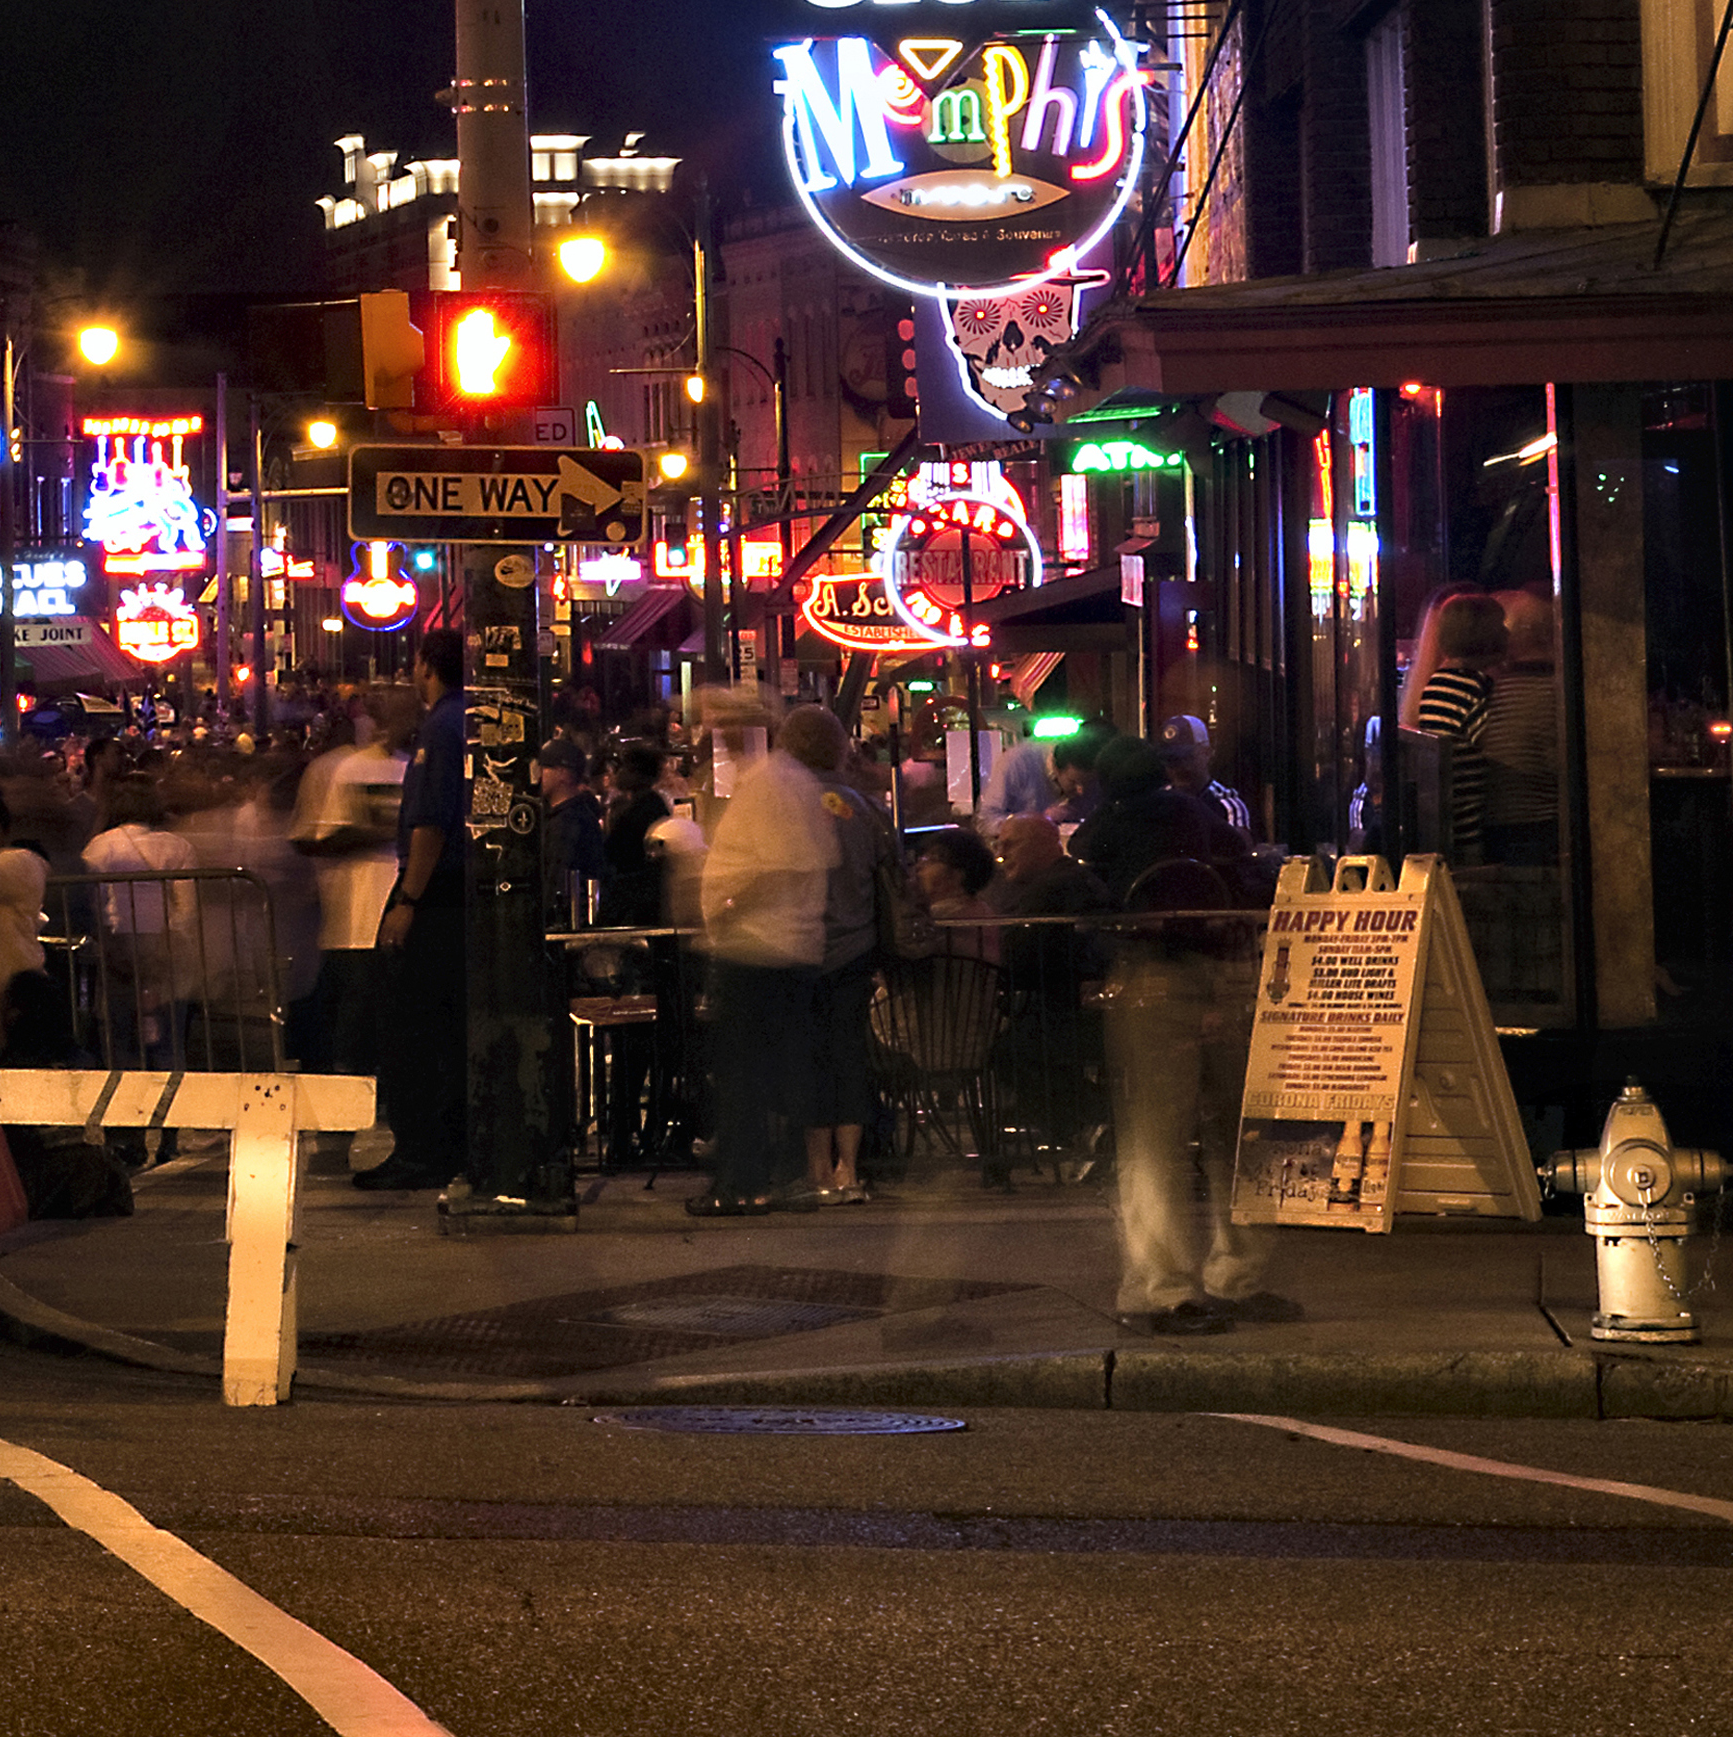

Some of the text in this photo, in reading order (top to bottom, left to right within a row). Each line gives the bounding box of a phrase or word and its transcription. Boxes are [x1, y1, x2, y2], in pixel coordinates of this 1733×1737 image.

[773, 32, 1154, 192] Memphis
[385, 475, 559, 513] ONE WAY
[896, 548, 1028, 587] RESTARANT
[813, 582, 849, 618] A.
[40, 627, 83, 642] JOINT
[843, 624, 925, 640] ESTABLISHE
[1272, 910, 1418, 932] HAPPY HOUR
[1339, 956, 1363, 966] WELL
[1365, 956, 1400, 966] DRINKS
[1260, 1011, 1406, 1023] SIGNATURE DRINKS DAILY
[1245, 1091, 1397, 1111] CORONA FRIDAYS
